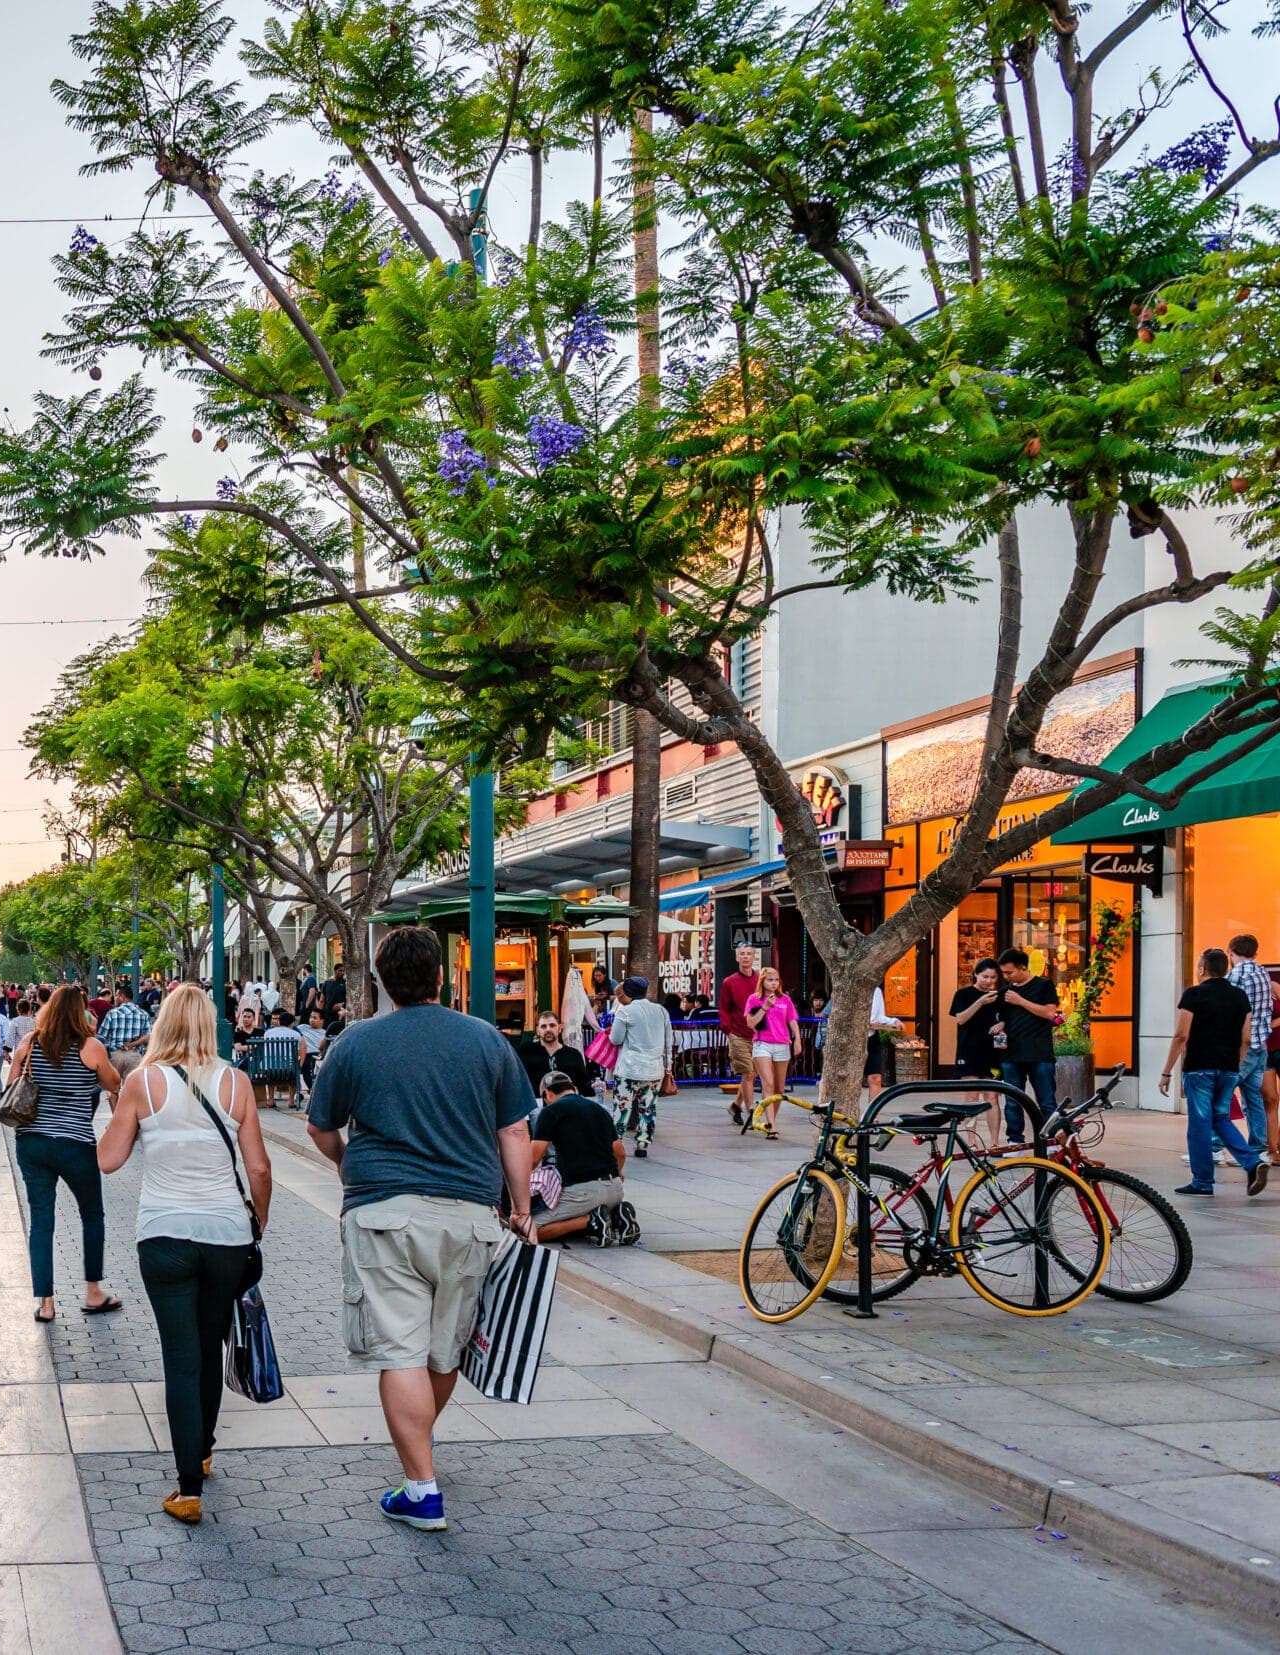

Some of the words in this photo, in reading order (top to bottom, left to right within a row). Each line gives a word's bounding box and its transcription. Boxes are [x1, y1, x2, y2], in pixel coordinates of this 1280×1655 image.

[1122, 807, 1159, 827] Clarks
[1090, 855, 1154, 874] Clarks
[733, 928, 770, 949] ATM
[658, 959, 696, 977] DESTROY
[662, 977, 692, 994] ORDER
